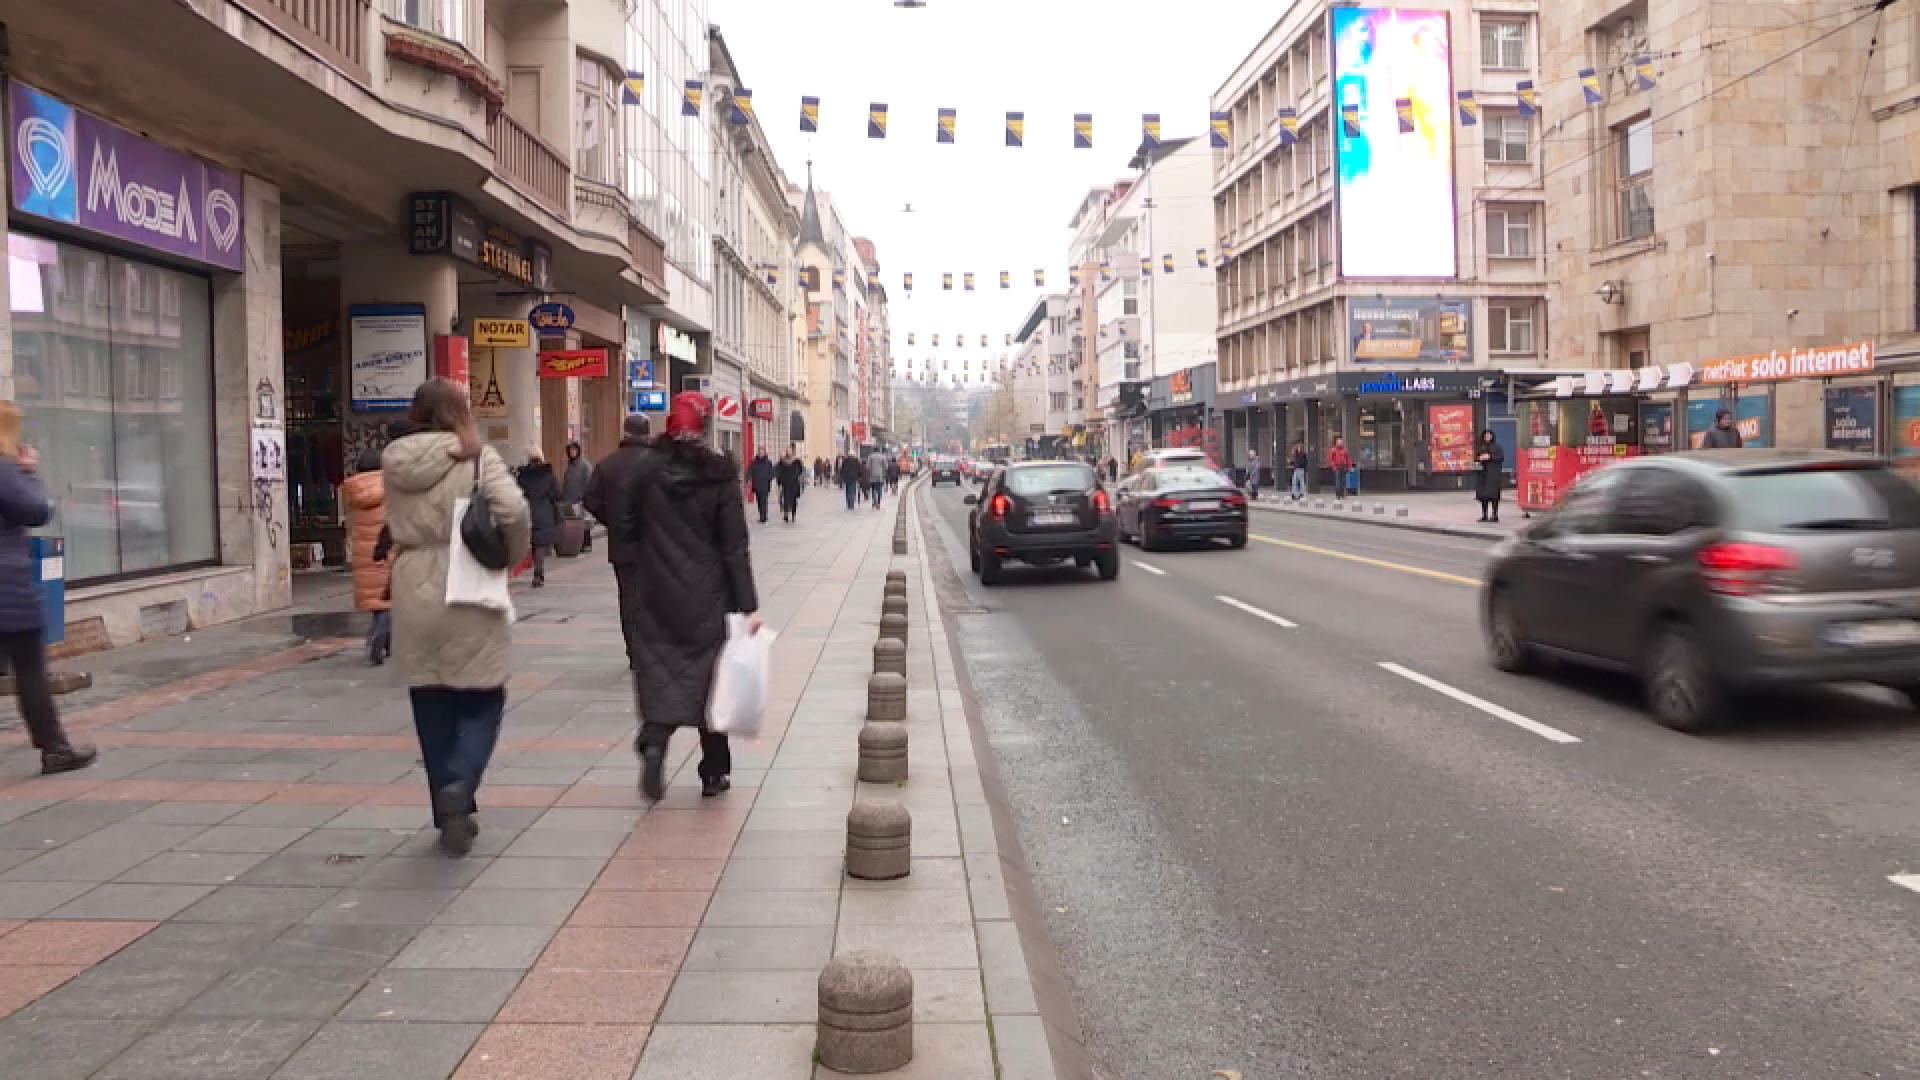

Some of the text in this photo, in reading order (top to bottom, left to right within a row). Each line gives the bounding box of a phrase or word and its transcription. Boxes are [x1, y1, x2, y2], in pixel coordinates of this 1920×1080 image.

[478, 321, 525, 335] NOTAR
[1751, 350, 1787, 378] solo
[1790, 341, 1869, 374] internet
[1832, 425, 1872, 440] internet
